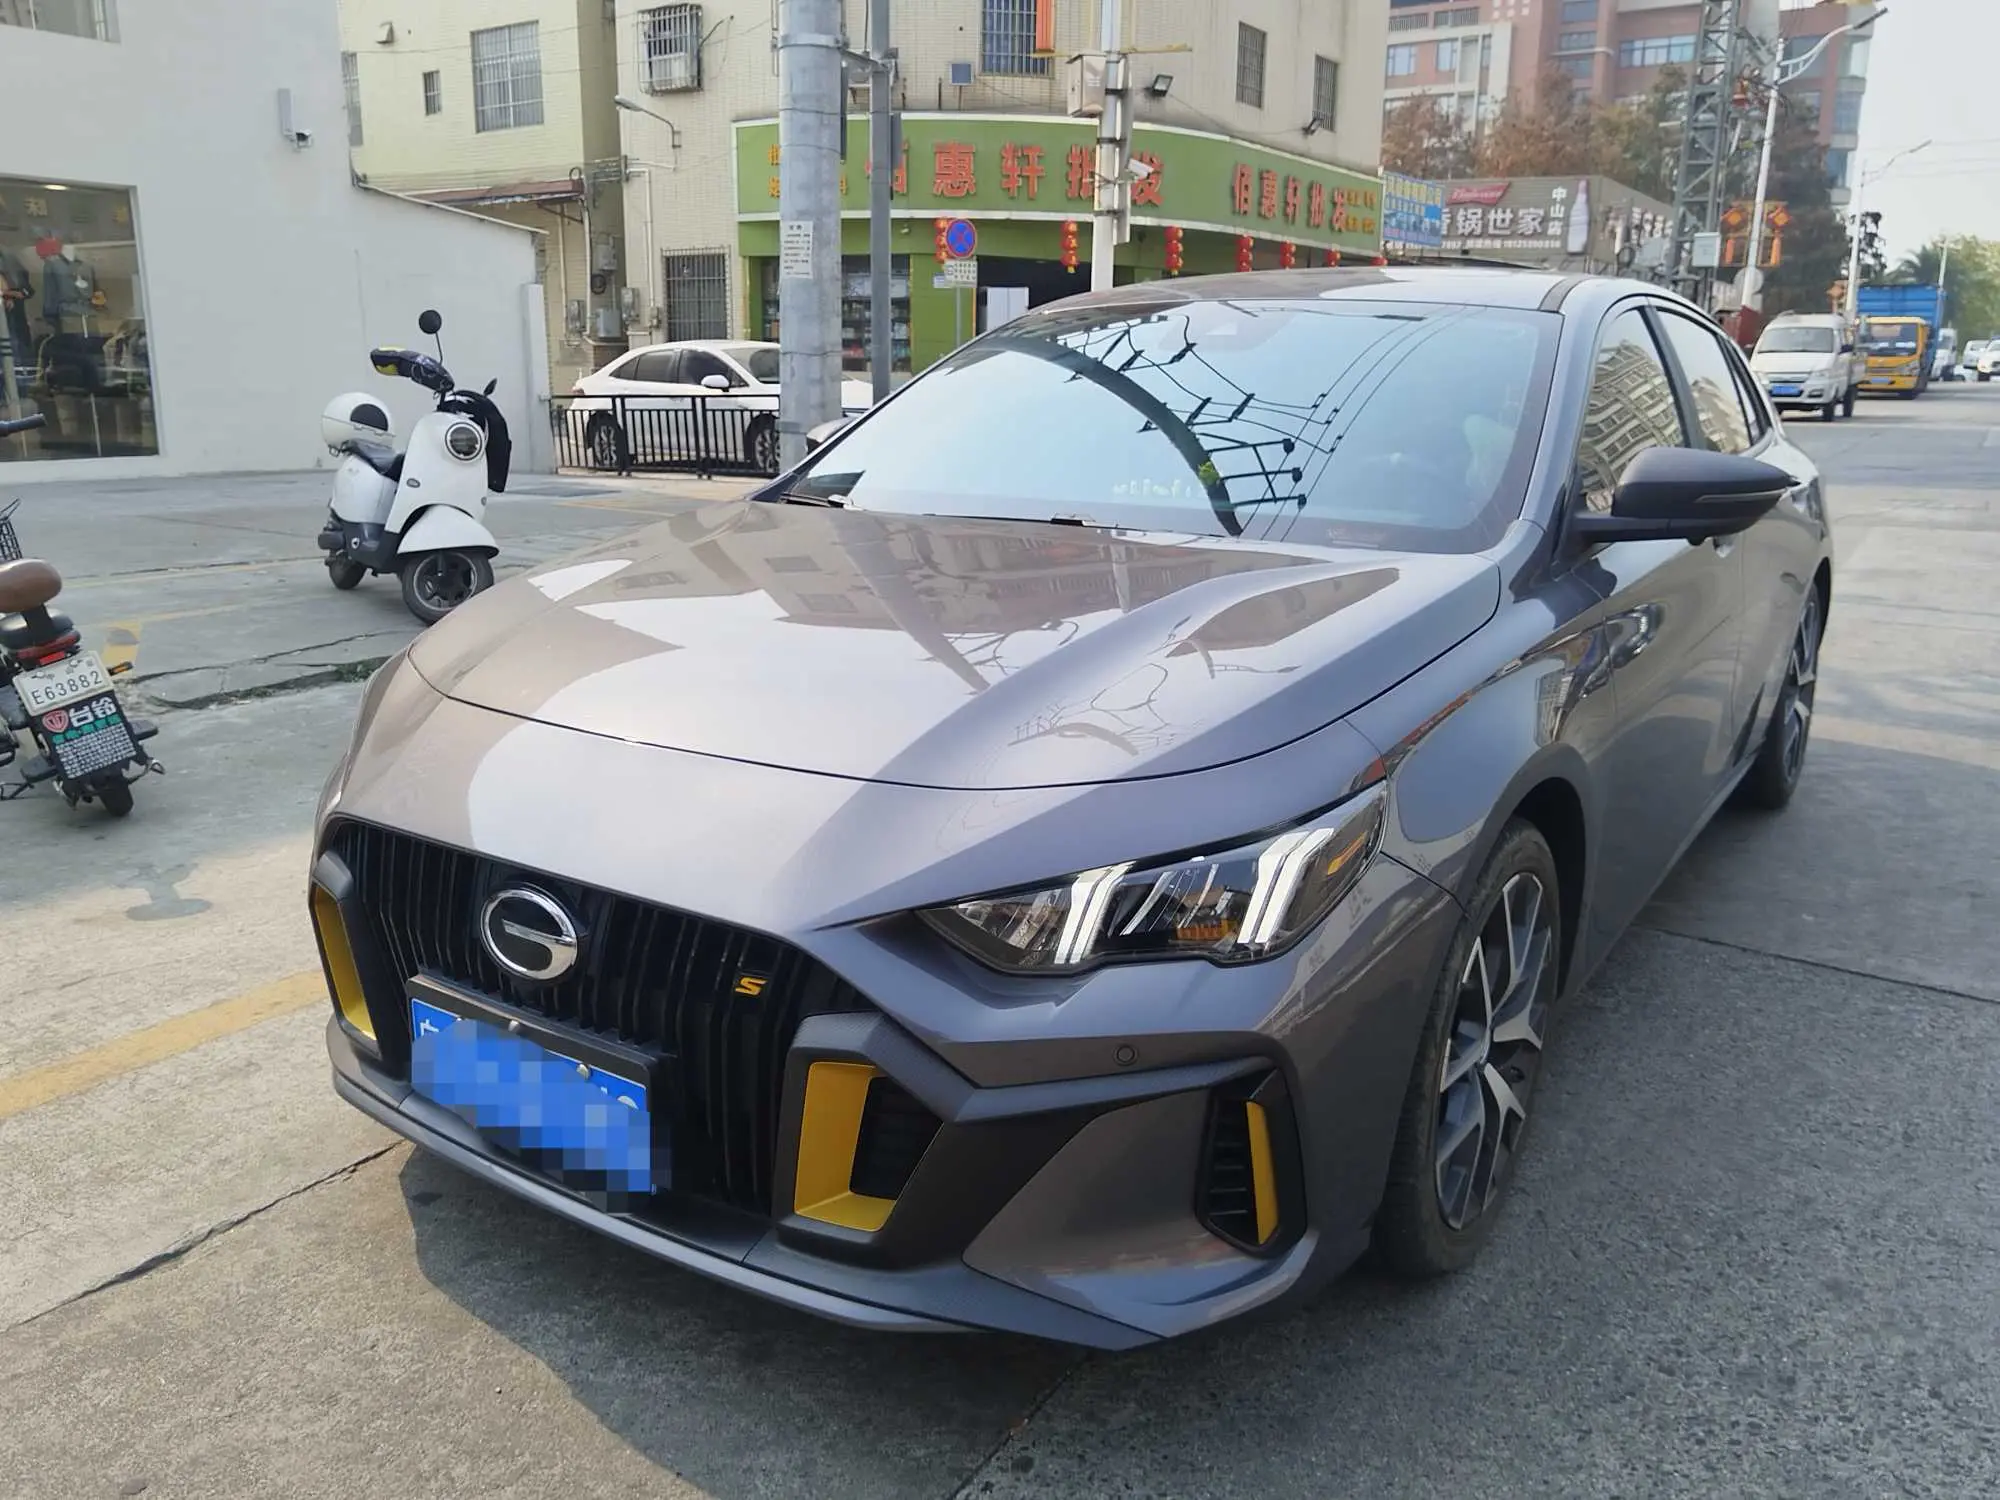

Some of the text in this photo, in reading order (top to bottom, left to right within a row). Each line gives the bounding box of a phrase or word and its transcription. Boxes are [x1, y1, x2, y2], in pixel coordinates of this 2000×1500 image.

[1547, 186, 1568, 236] 中山店
[31, 670, 102, 705] E63882
[69, 697, 117, 727] 台铃
[735, 977, 768, 995] S
